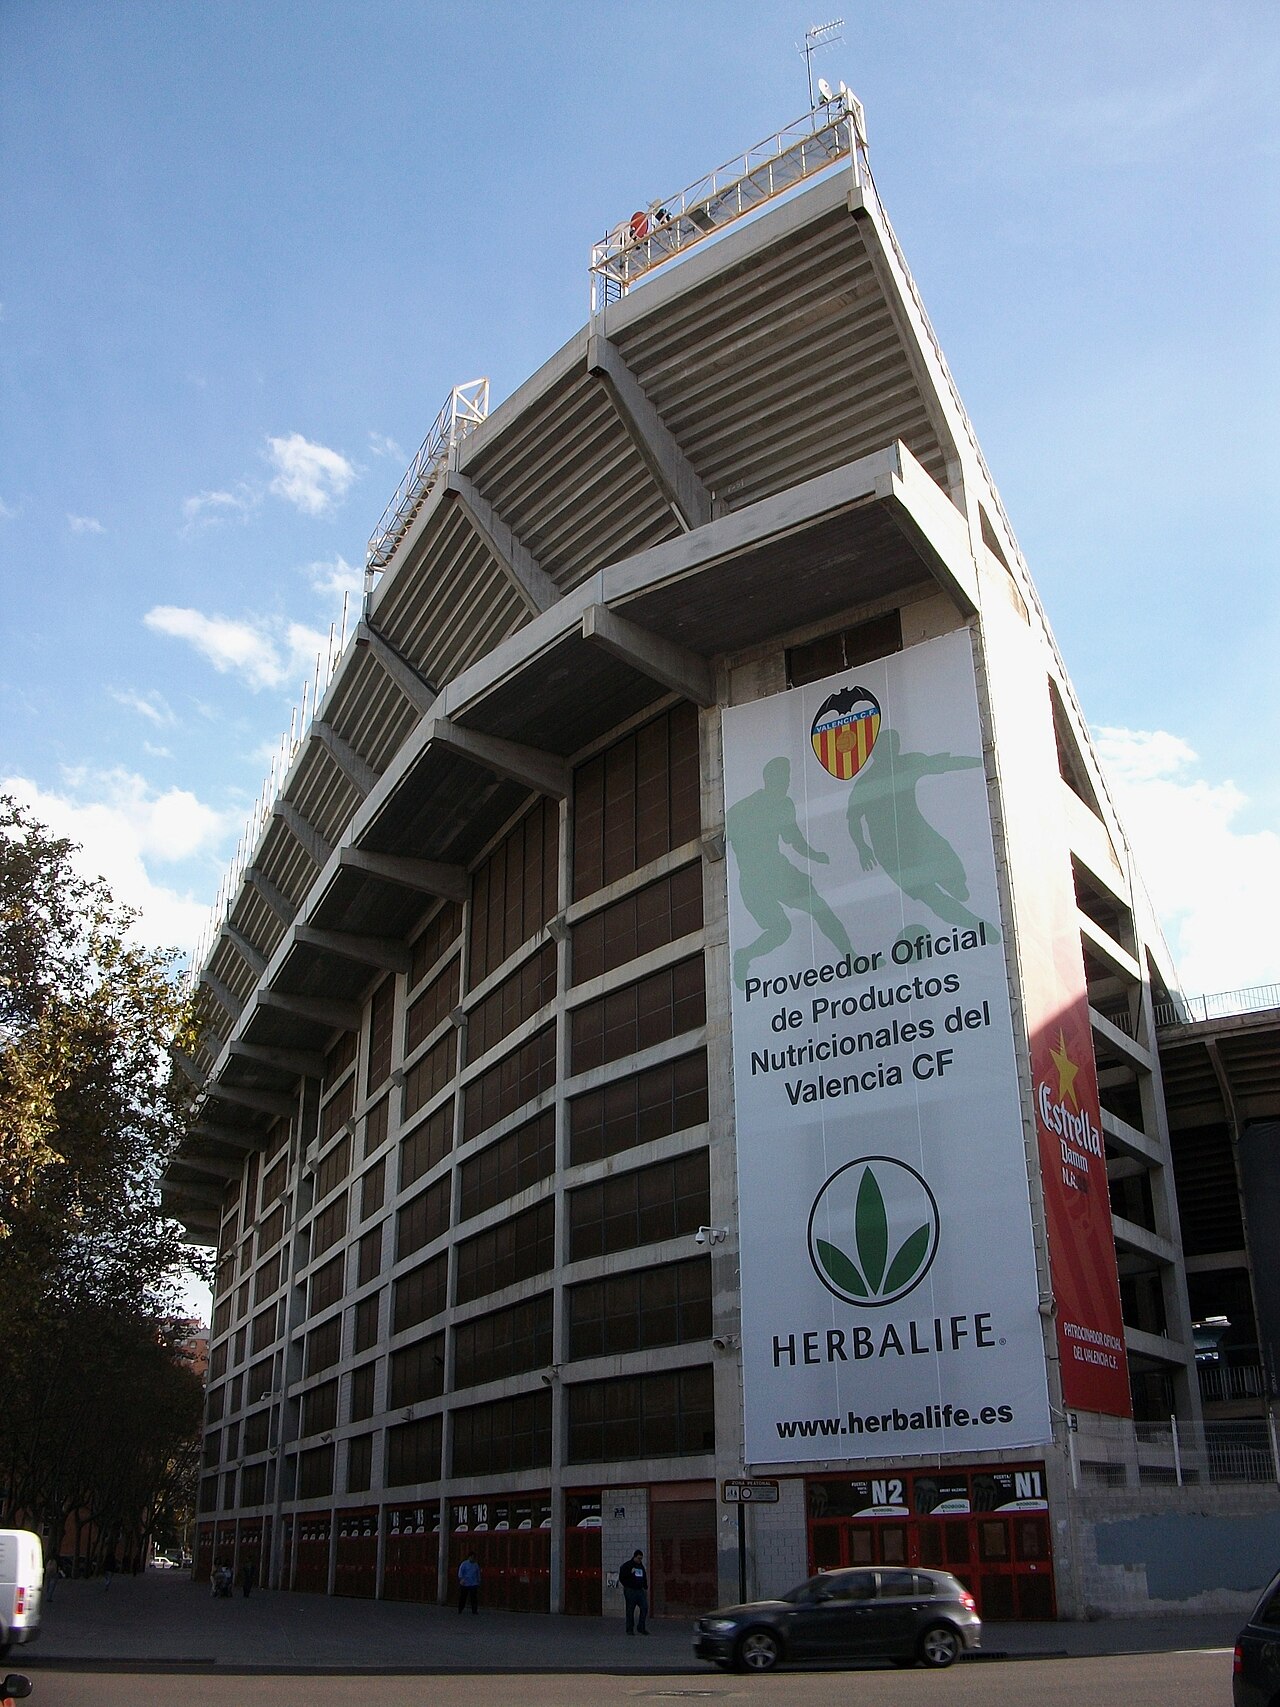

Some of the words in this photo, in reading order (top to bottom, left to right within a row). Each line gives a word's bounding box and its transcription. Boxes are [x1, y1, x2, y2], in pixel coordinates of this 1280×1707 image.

[816, 715, 858, 732] VALENCIA
[860, 708, 876, 719] C.F.
[745, 948, 882, 1001] Proveedor
[891, 921, 987, 964] Oficial
[771, 1006, 803, 1033] de
[813, 972, 960, 1024] Productos
[751, 1015, 936, 1075] Nutricionales
[945, 1000, 990, 1034] del
[785, 1062, 902, 1106] Valencia
[912, 1049, 954, 1080] CF
[1038, 1081, 1102, 1158] Estrella
[1060, 1138, 1088, 1173] Damm
[772, 1312, 996, 1367] HERBALIFE
[1063, 1321, 1104, 1346] PATROCINADOR
[1104, 1334, 1122, 1351] OFICIAL
[1073, 1345, 1084, 1361] DEL
[1084, 1348, 1109, 1367] VALENCIA
[776, 1402, 1013, 1439] www.herbalife.es
[871, 1478, 904, 1505] N2
[1015, 1471, 1042, 1499] N1
[477, 1504, 488, 1522] N3
